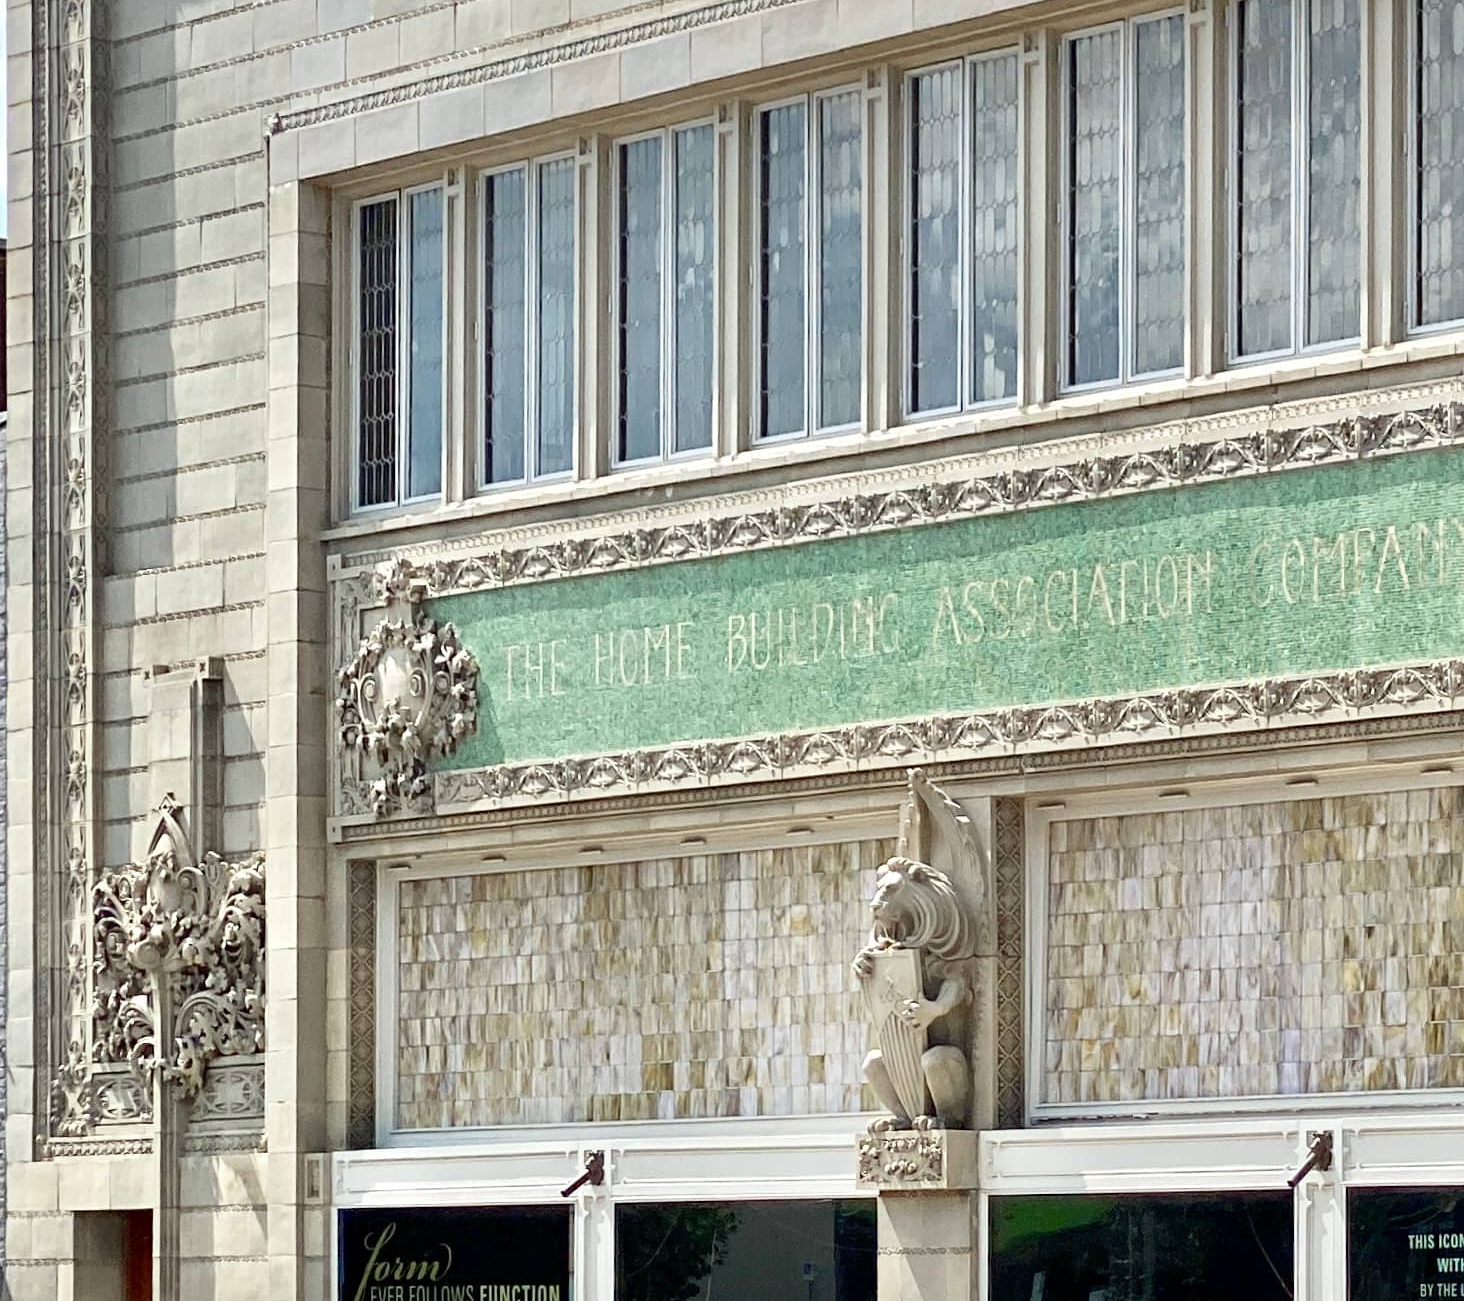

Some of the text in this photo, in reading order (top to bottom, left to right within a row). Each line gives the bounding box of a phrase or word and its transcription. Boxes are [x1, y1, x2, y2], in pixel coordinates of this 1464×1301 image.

[502, 639, 567, 699] THE
[594, 622, 697, 686] HOME
[726, 591, 900, 674] BUILDING
[932, 550, 1213, 649] ASSOCIATION
[1407, 1234, 1435, 1249] THIS
[1419, 1283, 1437, 1298] BY
[1437, 1283, 1458, 1297] THE
